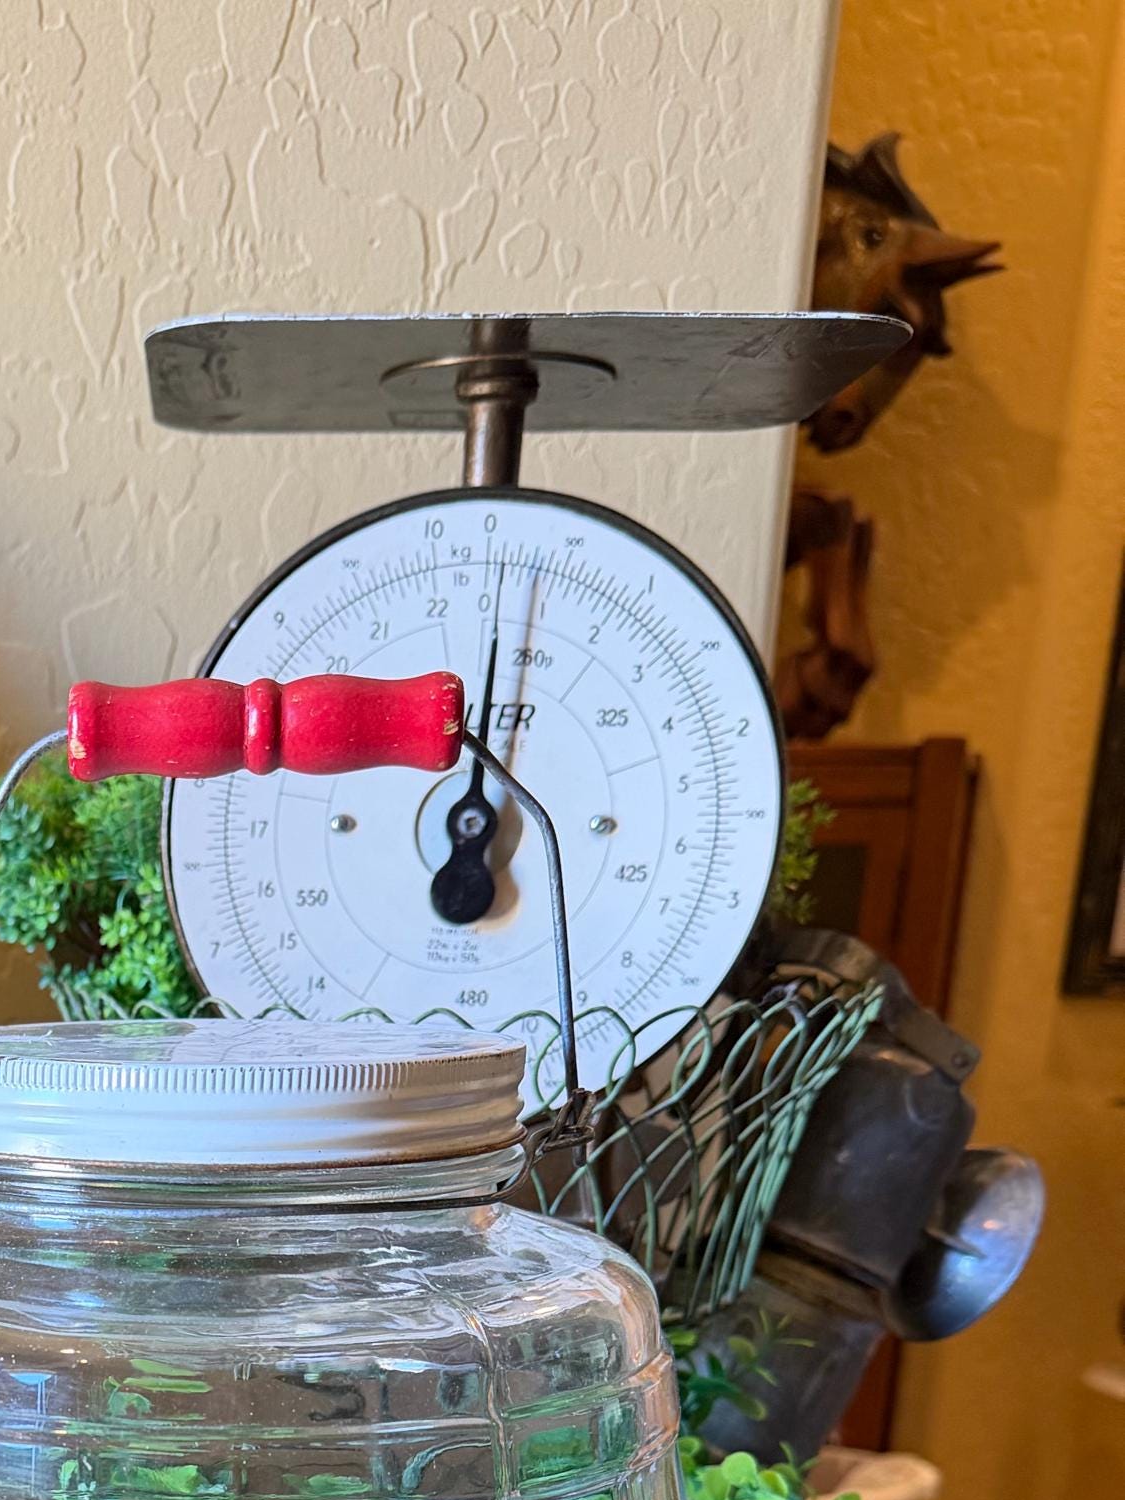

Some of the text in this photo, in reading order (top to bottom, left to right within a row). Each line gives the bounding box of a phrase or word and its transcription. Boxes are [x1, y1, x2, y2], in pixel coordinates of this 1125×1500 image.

[425, 519, 444, 540] 10
[484, 514, 497, 533] 0
[450, 545, 472, 562] kg
[453, 571, 470, 587] lb
[426, 599, 449, 618] 22
[477, 594, 491, 613] 0
[274, 611, 285, 630] 9
[369, 621, 390, 641] 21
[587, 625, 601, 644] 2
[325, 655, 350, 674] 20
[631, 664, 643, 683] 3
[595, 708, 629, 728] 325
[661, 716, 674, 735] 4
[736, 717, 750, 738] 2
[676, 773, 690, 794] 5
[250, 820, 269, 839] 17
[675, 835, 688, 855] 6
[614, 864, 648, 883] 425
[258, 881, 275, 899] 16
[295, 888, 329, 908] 550
[659, 898, 671, 916] 7
[727, 890, 740, 910] 3
[210, 941, 221, 959] 7
[279, 932, 298, 951] 15
[620, 950, 633, 969] 8
[308, 975, 327, 994] 14
[455, 989, 489, 1007] 480
[576, 990, 588, 1007] 9
